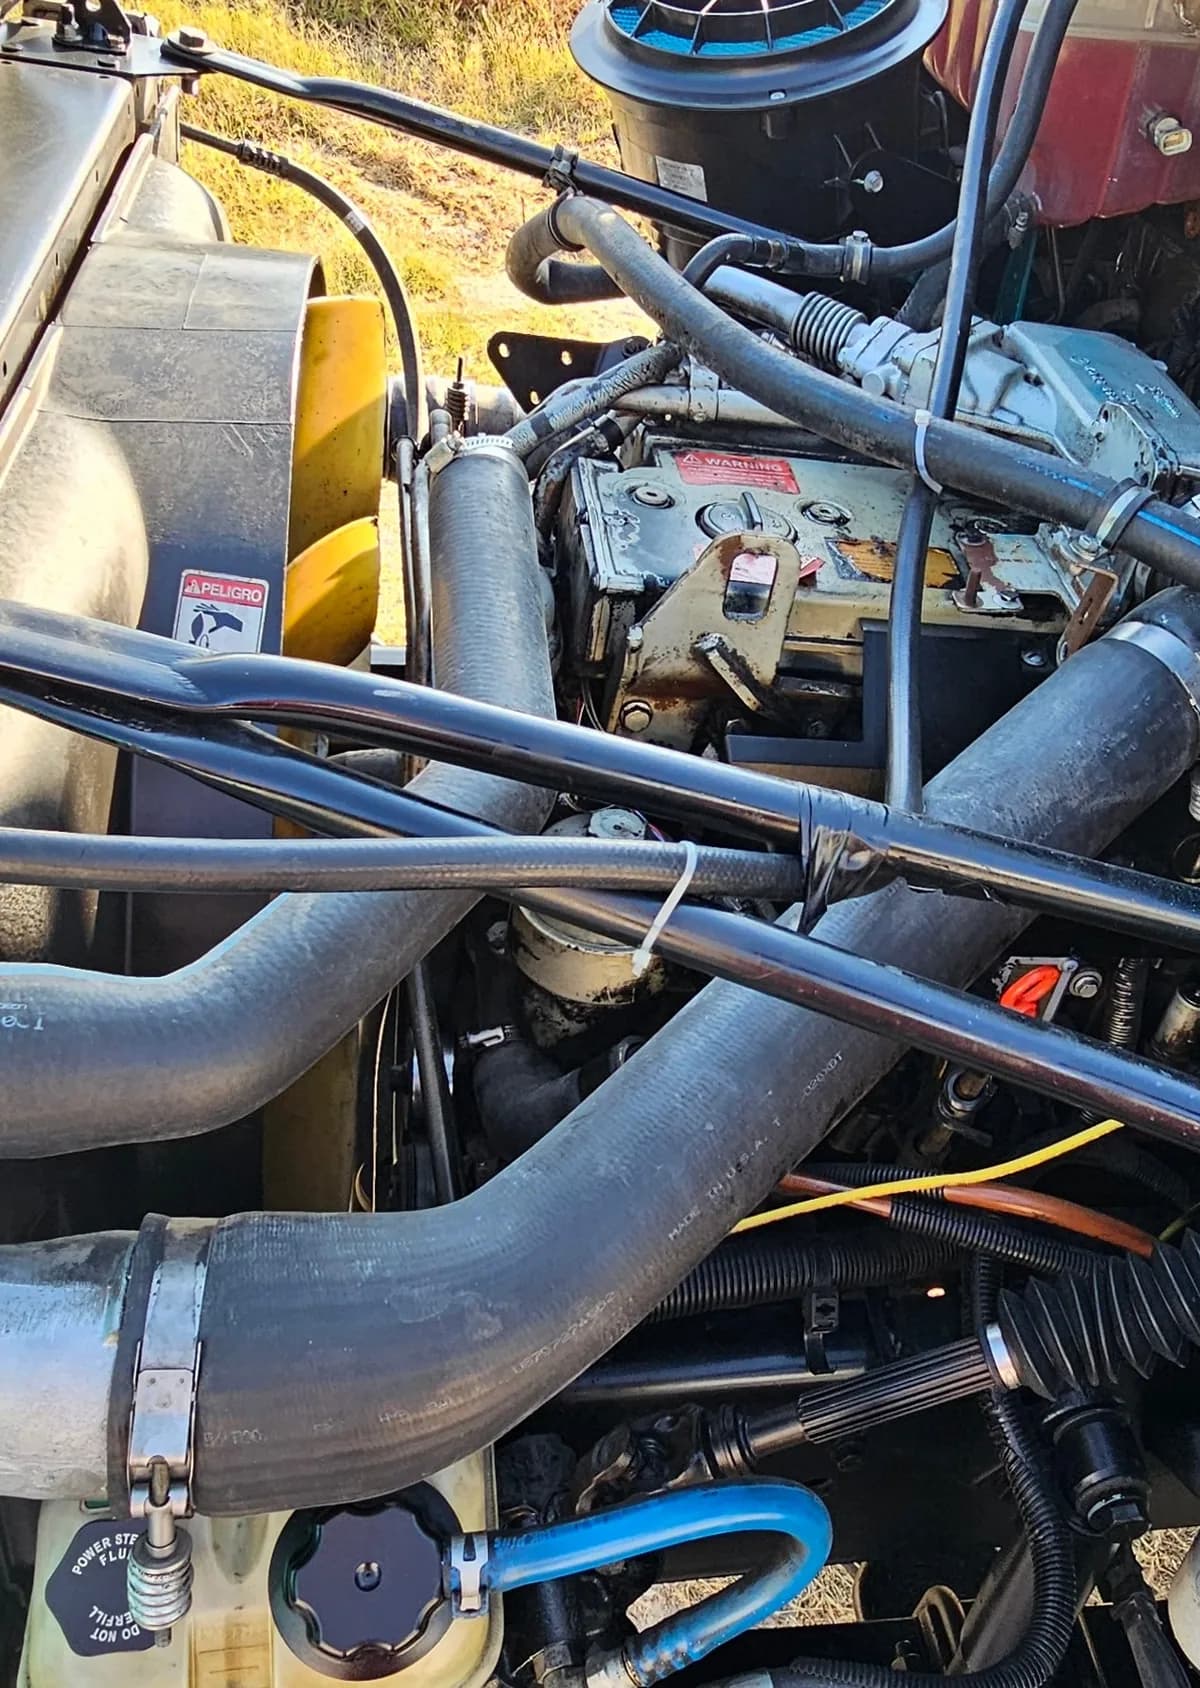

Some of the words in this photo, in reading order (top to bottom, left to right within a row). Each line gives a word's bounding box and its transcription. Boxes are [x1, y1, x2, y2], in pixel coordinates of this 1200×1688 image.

[704, 457, 783, 472] WARNING
[201, 582, 263, 603] PELIGRO
[72, 1537, 112, 1575] POWER
[88, 1605, 134, 1628] ERFILL
[89, 1627, 118, 1644] NOT
[121, 1623, 141, 1641] DO
